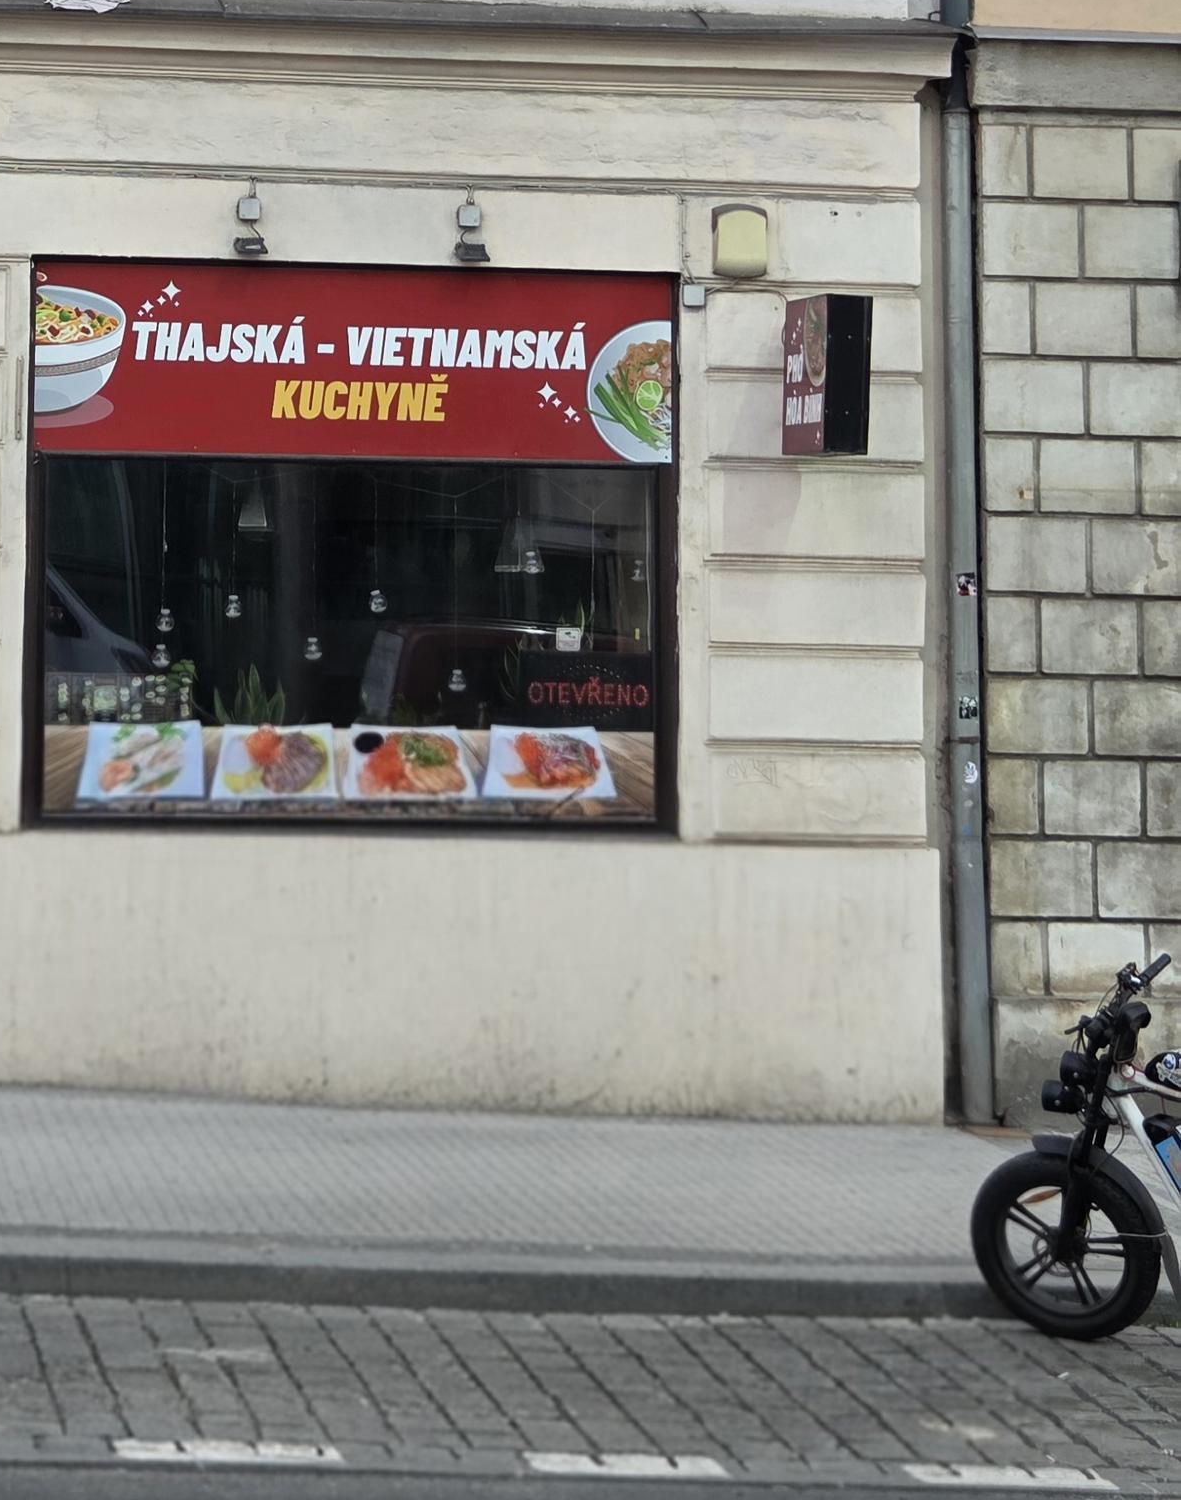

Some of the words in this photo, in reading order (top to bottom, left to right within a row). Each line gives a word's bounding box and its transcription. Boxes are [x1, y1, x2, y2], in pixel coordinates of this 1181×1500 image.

[131, 316, 307, 366] THAJSKÁ
[346, 322, 587, 371] VIETNAMSKÁ
[271, 373, 450, 423] KUCHYNĚ
[528, 676, 650, 708] OTEVŘENO
